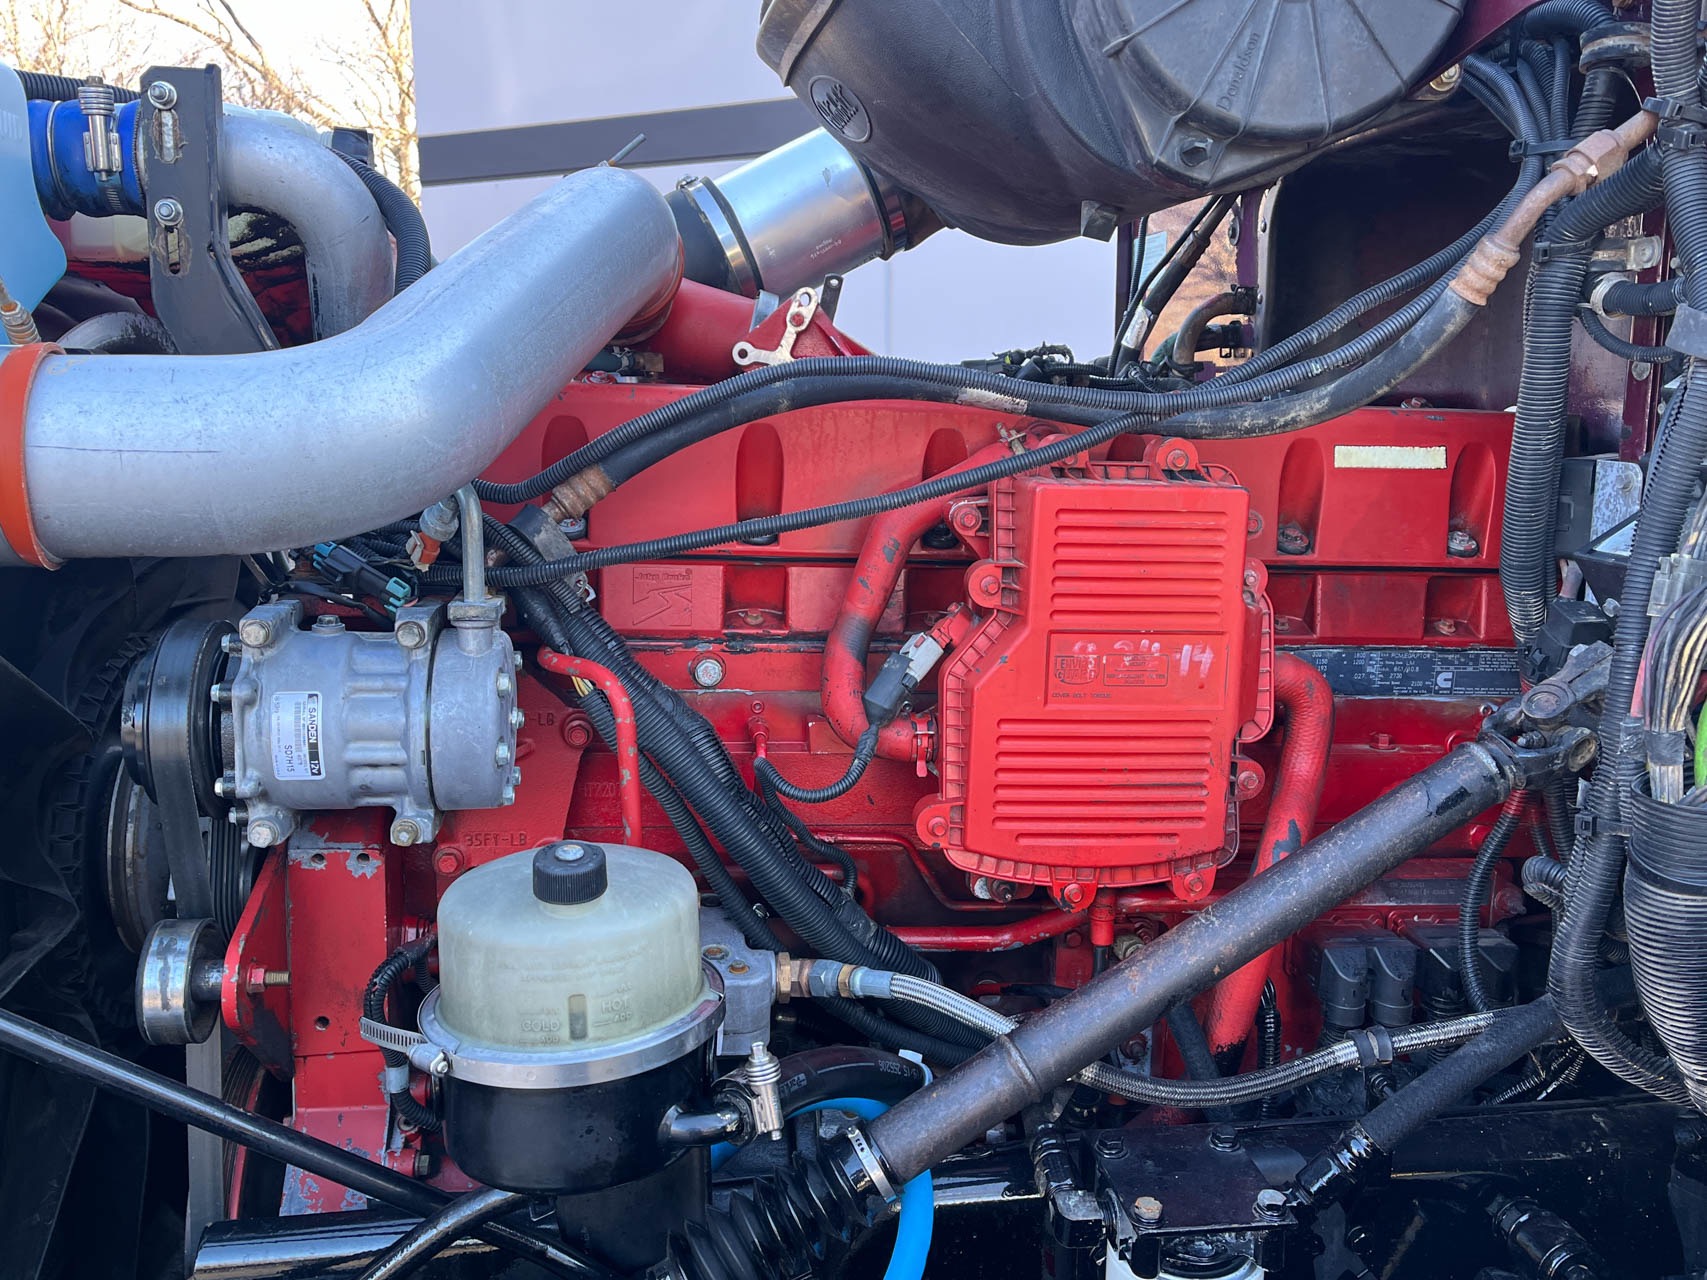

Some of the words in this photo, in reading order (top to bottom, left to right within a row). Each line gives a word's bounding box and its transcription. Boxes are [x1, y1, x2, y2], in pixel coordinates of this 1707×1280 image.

[1216, 32, 1261, 112] Donaldson
[308, 707, 318, 743] SANDEN
[284, 744, 295, 773] SD7H15
[310, 760, 320, 774] 12V
[602, 1000, 631, 1015] HOT
[521, 1019, 560, 1032] COLD
